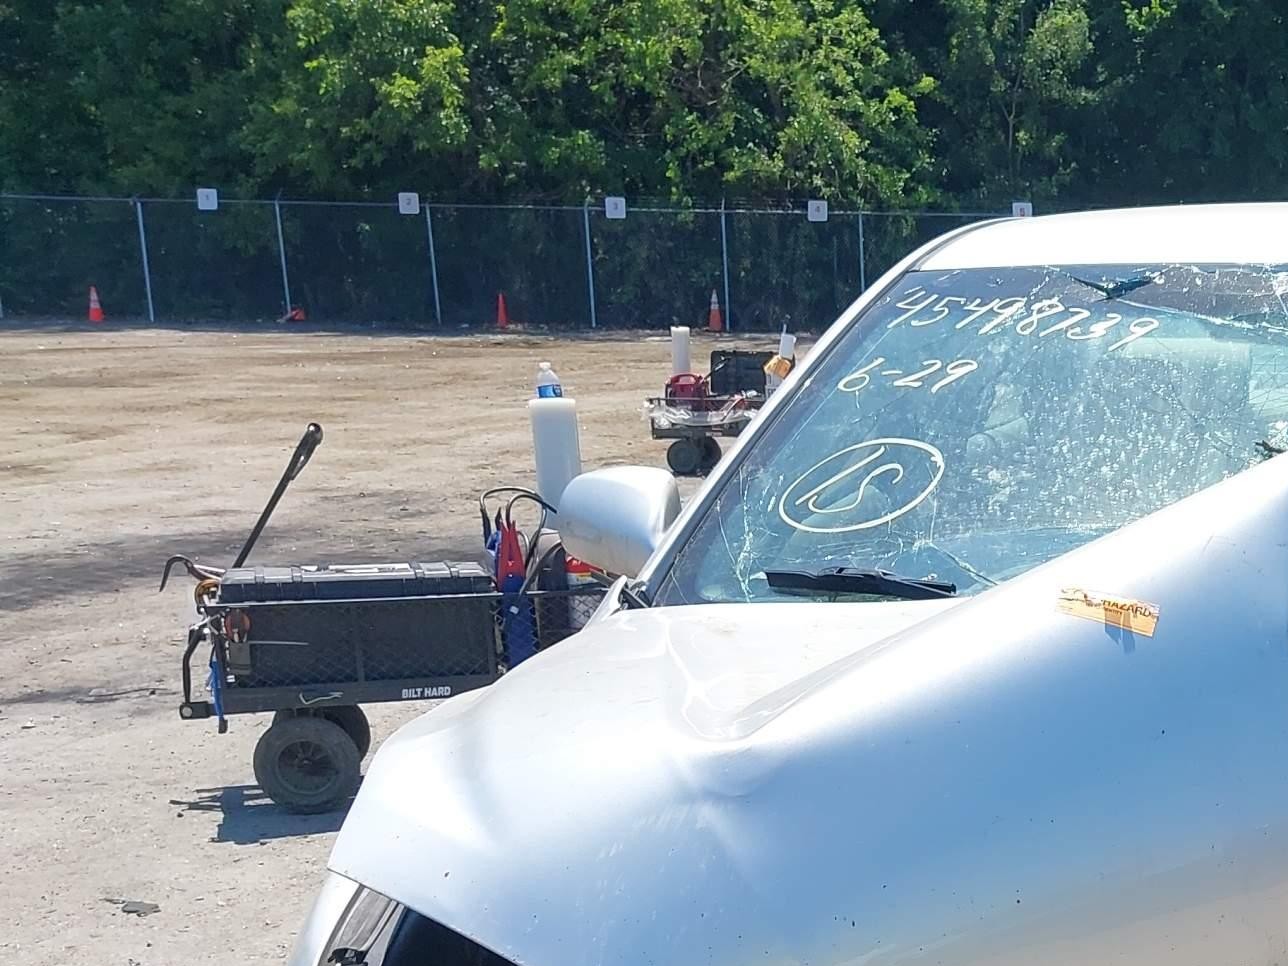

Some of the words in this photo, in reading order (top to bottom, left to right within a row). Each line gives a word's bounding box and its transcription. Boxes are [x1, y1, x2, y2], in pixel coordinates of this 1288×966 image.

[887, 286, 1160, 351] 45498739
[837, 357, 978, 394] 6-29
[402, 688, 422, 698] BILT
[424, 686, 451, 697] HARD
